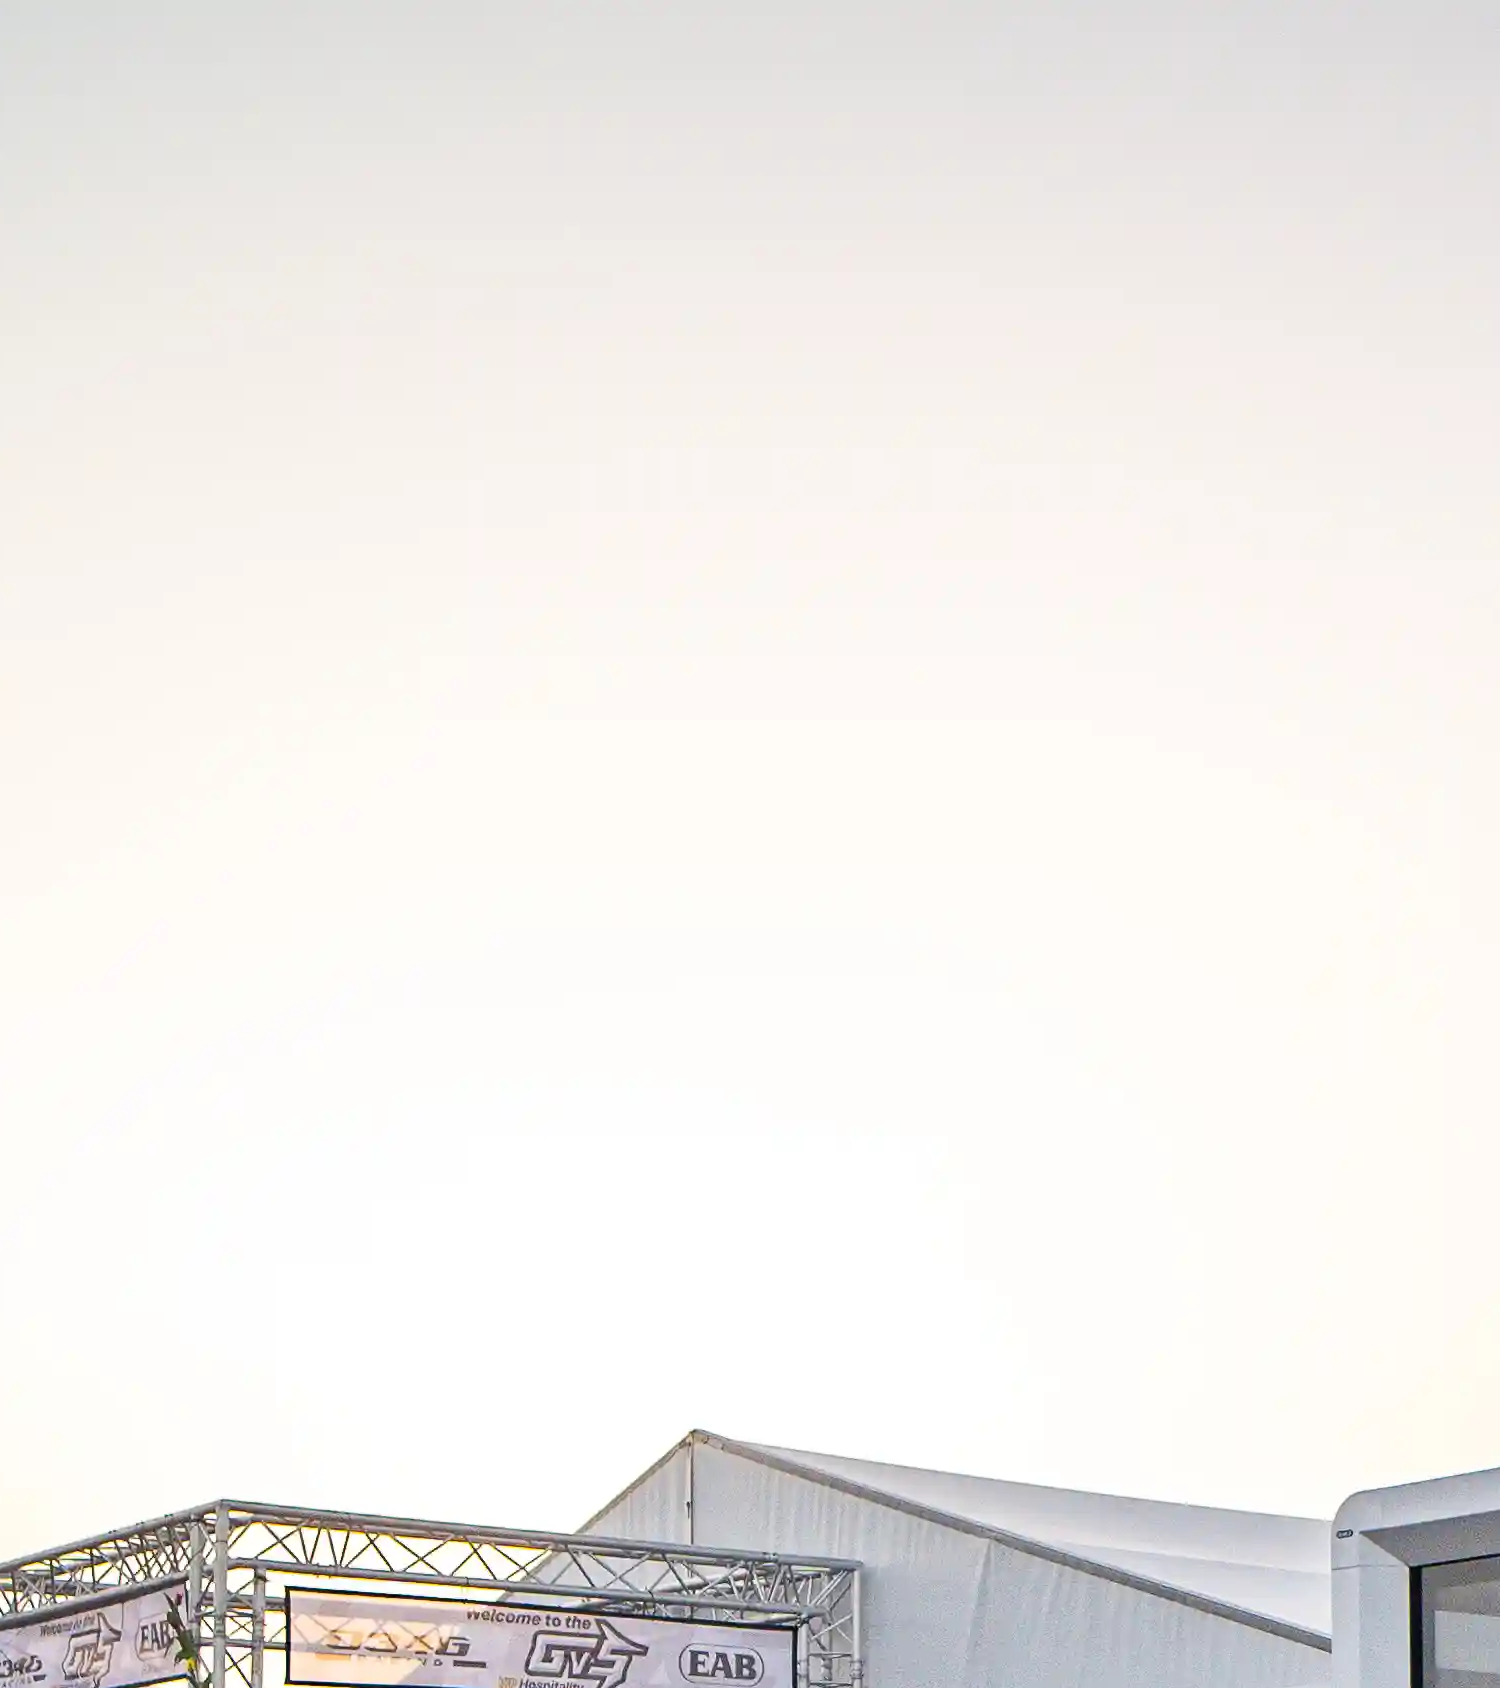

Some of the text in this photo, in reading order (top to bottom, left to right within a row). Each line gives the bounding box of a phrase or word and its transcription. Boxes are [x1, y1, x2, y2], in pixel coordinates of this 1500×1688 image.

[545, 1613, 562, 1629] to
[564, 1615, 592, 1631] the
[687, 1649, 757, 1681] EAB
